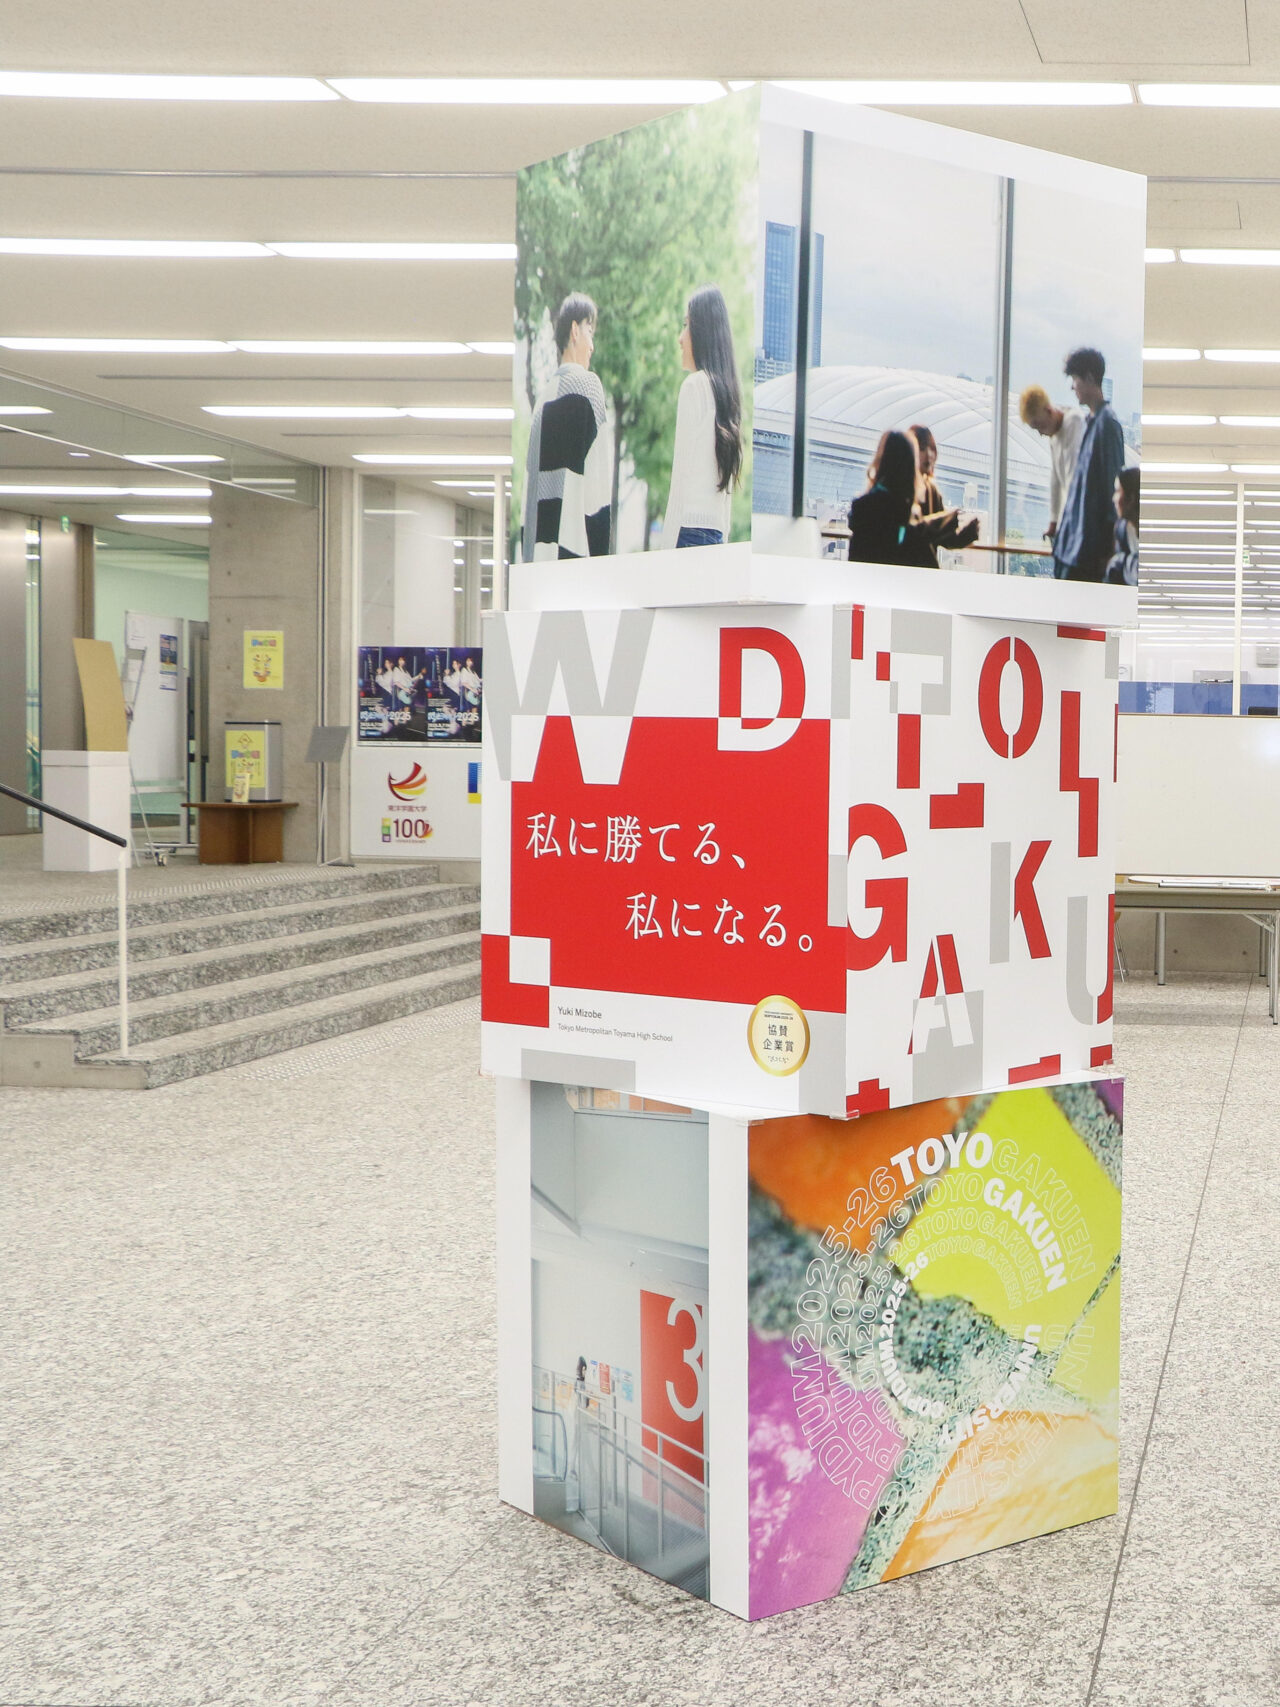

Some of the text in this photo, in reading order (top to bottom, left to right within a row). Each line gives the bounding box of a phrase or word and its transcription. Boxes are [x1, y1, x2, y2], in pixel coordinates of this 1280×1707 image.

[393, 818, 425, 838] 100
[525, 812, 747, 869] 私に勝てる、
[624, 892, 814, 953] 私になる。
[557, 1005, 603, 1020] Yuki Mizobe
[557, 1022, 674, 1042] Tokyo Metropolitan Toyama High School
[768, 1023, 788, 1038] 協賛
[763, 1038, 794, 1053] 企業賞
[891, 1132, 993, 1186] TOYO
[983, 1178, 1068, 1293] GAKUEN
[665, 1298, 705, 1422] 3
[938, 1324, 1042, 1447] UNIVERSITY
